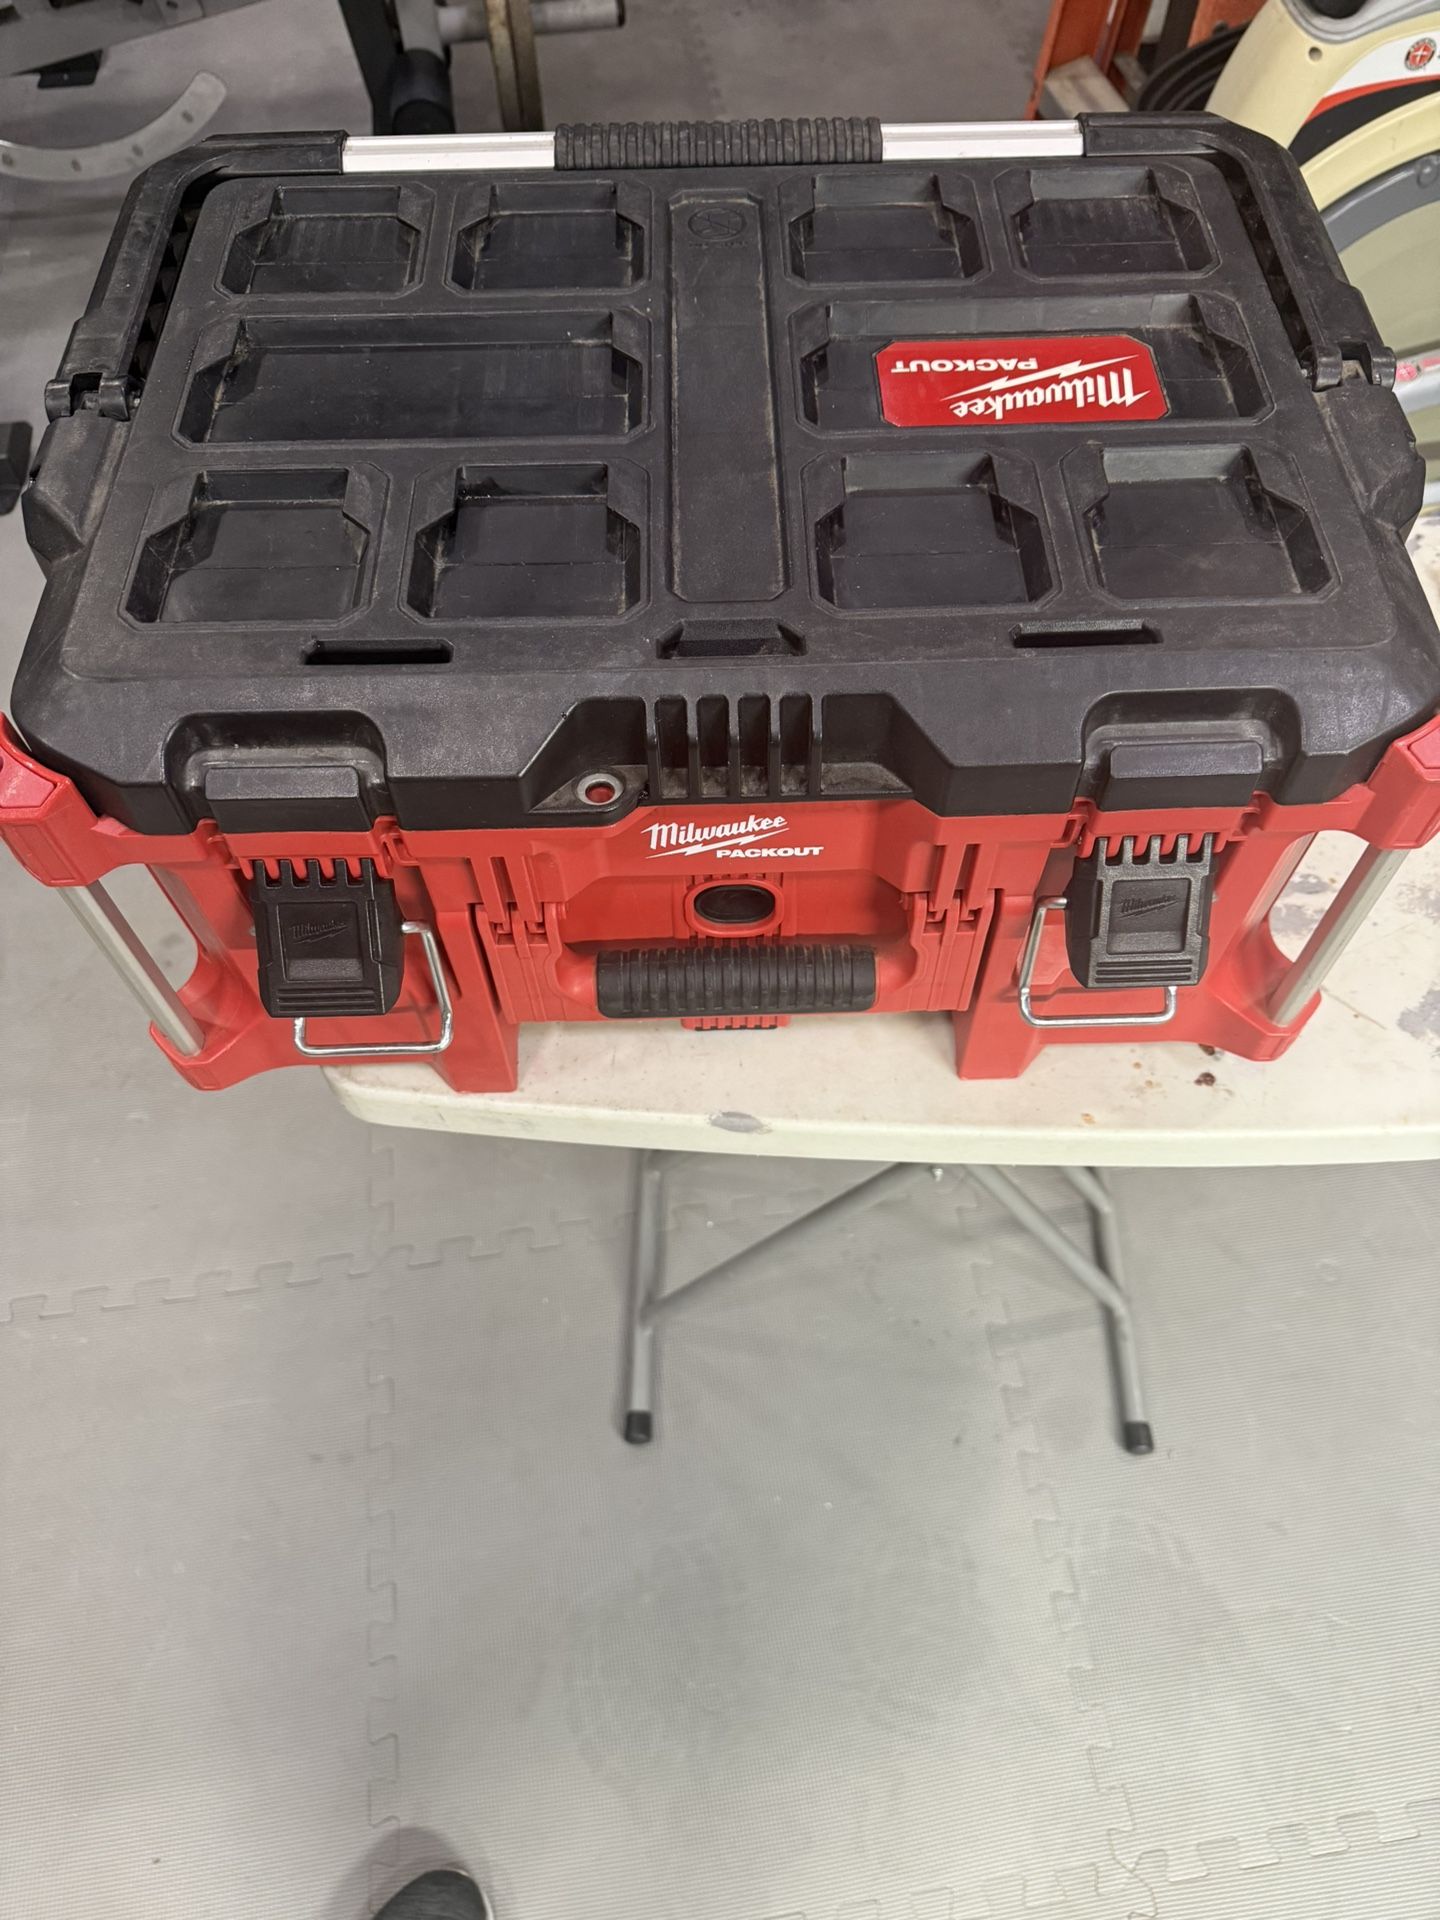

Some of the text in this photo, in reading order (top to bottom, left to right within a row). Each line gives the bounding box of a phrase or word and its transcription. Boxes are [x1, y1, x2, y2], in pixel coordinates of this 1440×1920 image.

[890, 358, 1039, 373] PACKOUT
[949, 367, 1151, 420] Milwaukee
[640, 814, 788, 850] Milwaukee
[716, 846, 825, 859] PACKOUT
